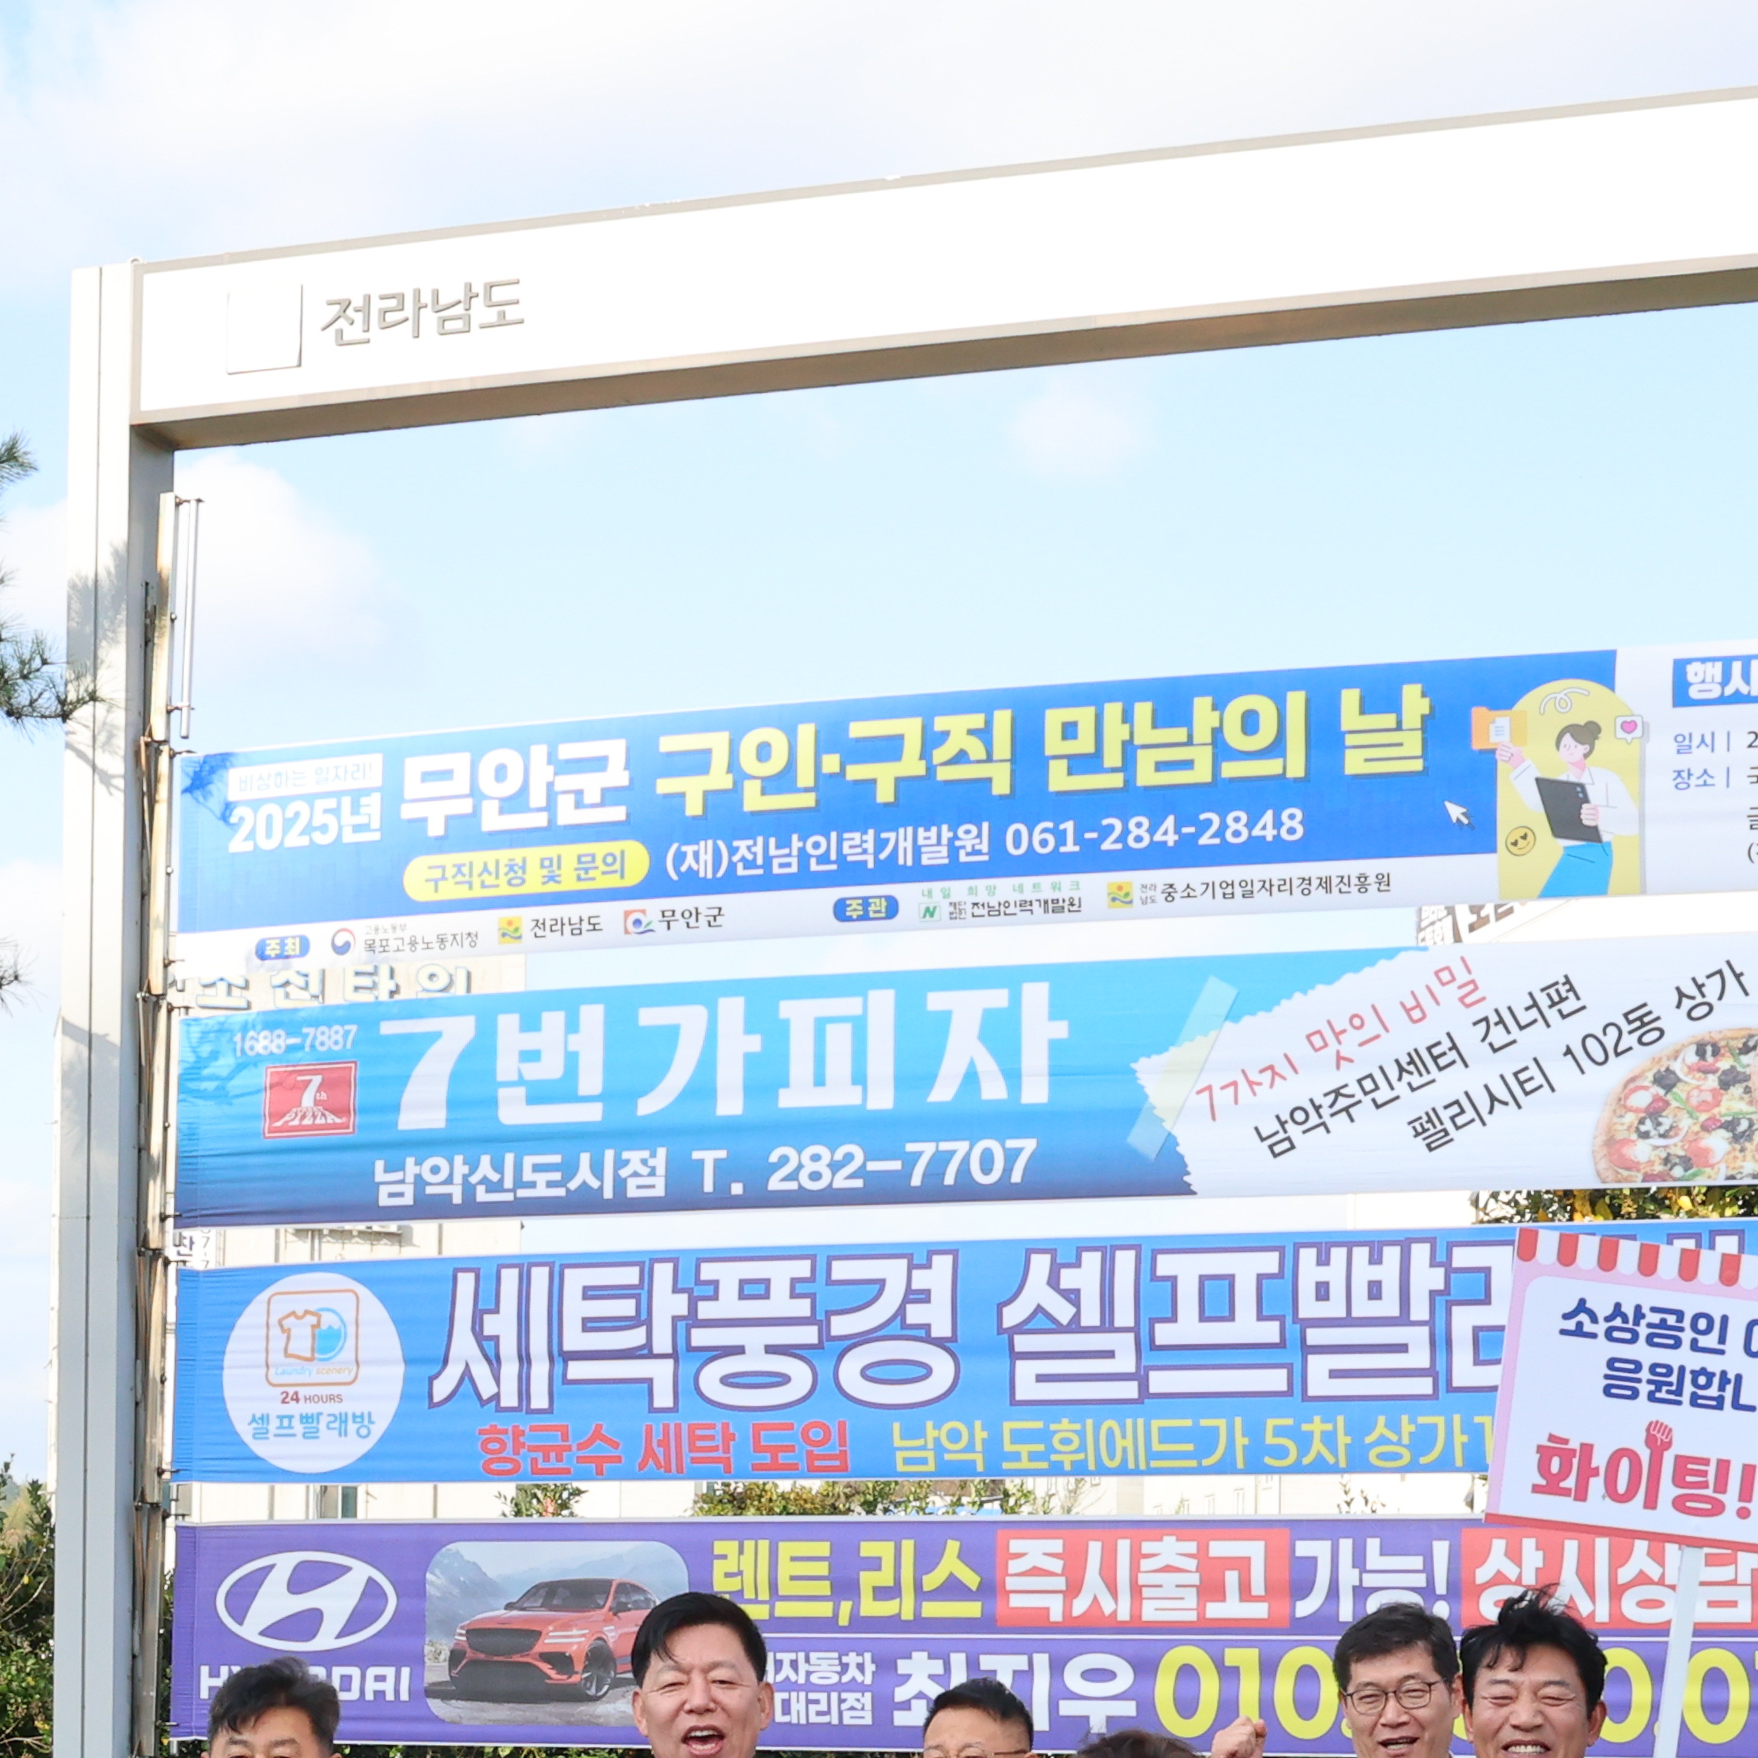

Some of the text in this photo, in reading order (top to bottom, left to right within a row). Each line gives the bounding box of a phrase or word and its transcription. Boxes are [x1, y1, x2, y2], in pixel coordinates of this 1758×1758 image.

[320, 278, 525, 347] 전라남도
[1673, 731, 1716, 755] 일시
[228, 792, 382, 854] 2025년
[400, 738, 631, 838] 무안군
[1043, 690, 1308, 793] 만남의
[1340, 683, 1430, 776] 날
[239, 763, 373, 793] 비상하는 일자리!
[1671, 767, 1717, 790] 장소
[666, 807, 1306, 881] (재)전남인력개발원 061-284-2848
[424, 848, 628, 894] 구직신청 및 문의
[1161, 871, 1393, 903] 중소기업일자리경제진흥원
[530, 914, 604, 939] 전라남도
[658, 907, 726, 931] 무안군
[844, 897, 889, 920] 주관
[970, 896, 1083, 920] 전남인력개발원
[363, 931, 479, 955] 목포고용노동지청
[233, 1024, 359, 1057] 1688-7887
[1195, 956, 1487, 1122] 7가지 맛의 비밀
[1406, 959, 1751, 1153] 펠리시티 102동 상가
[1254, 973, 1589, 1160] 남악주민센터 건너편
[373, 1147, 667, 1207] 남악신도시점
[767, 1138, 1038, 1193] 282-7707
[428, 1248, 961, 1413] 세탁풍경
[1559, 1297, 1729, 1356] 소상공인
[280, 1391, 344, 1404] 24 HOURS
[248, 1411, 376, 1440] 셀프빨래방
[892, 1419, 988, 1473] 남악
[1001, 1416, 1249, 1471] 도휘에드가
[1263, 1415, 1352, 1469] 5차
[478, 1419, 851, 1477] 향균수 세탁 도입
[1531, 1425, 1758, 1520] 화이팅!
[1006, 1535, 1270, 1622] 즉시출고
[1293, 1536, 1449, 1622] 가능!
[200, 1664, 411, 1701] HDAI
[767, 1651, 876, 1685] 자동차
